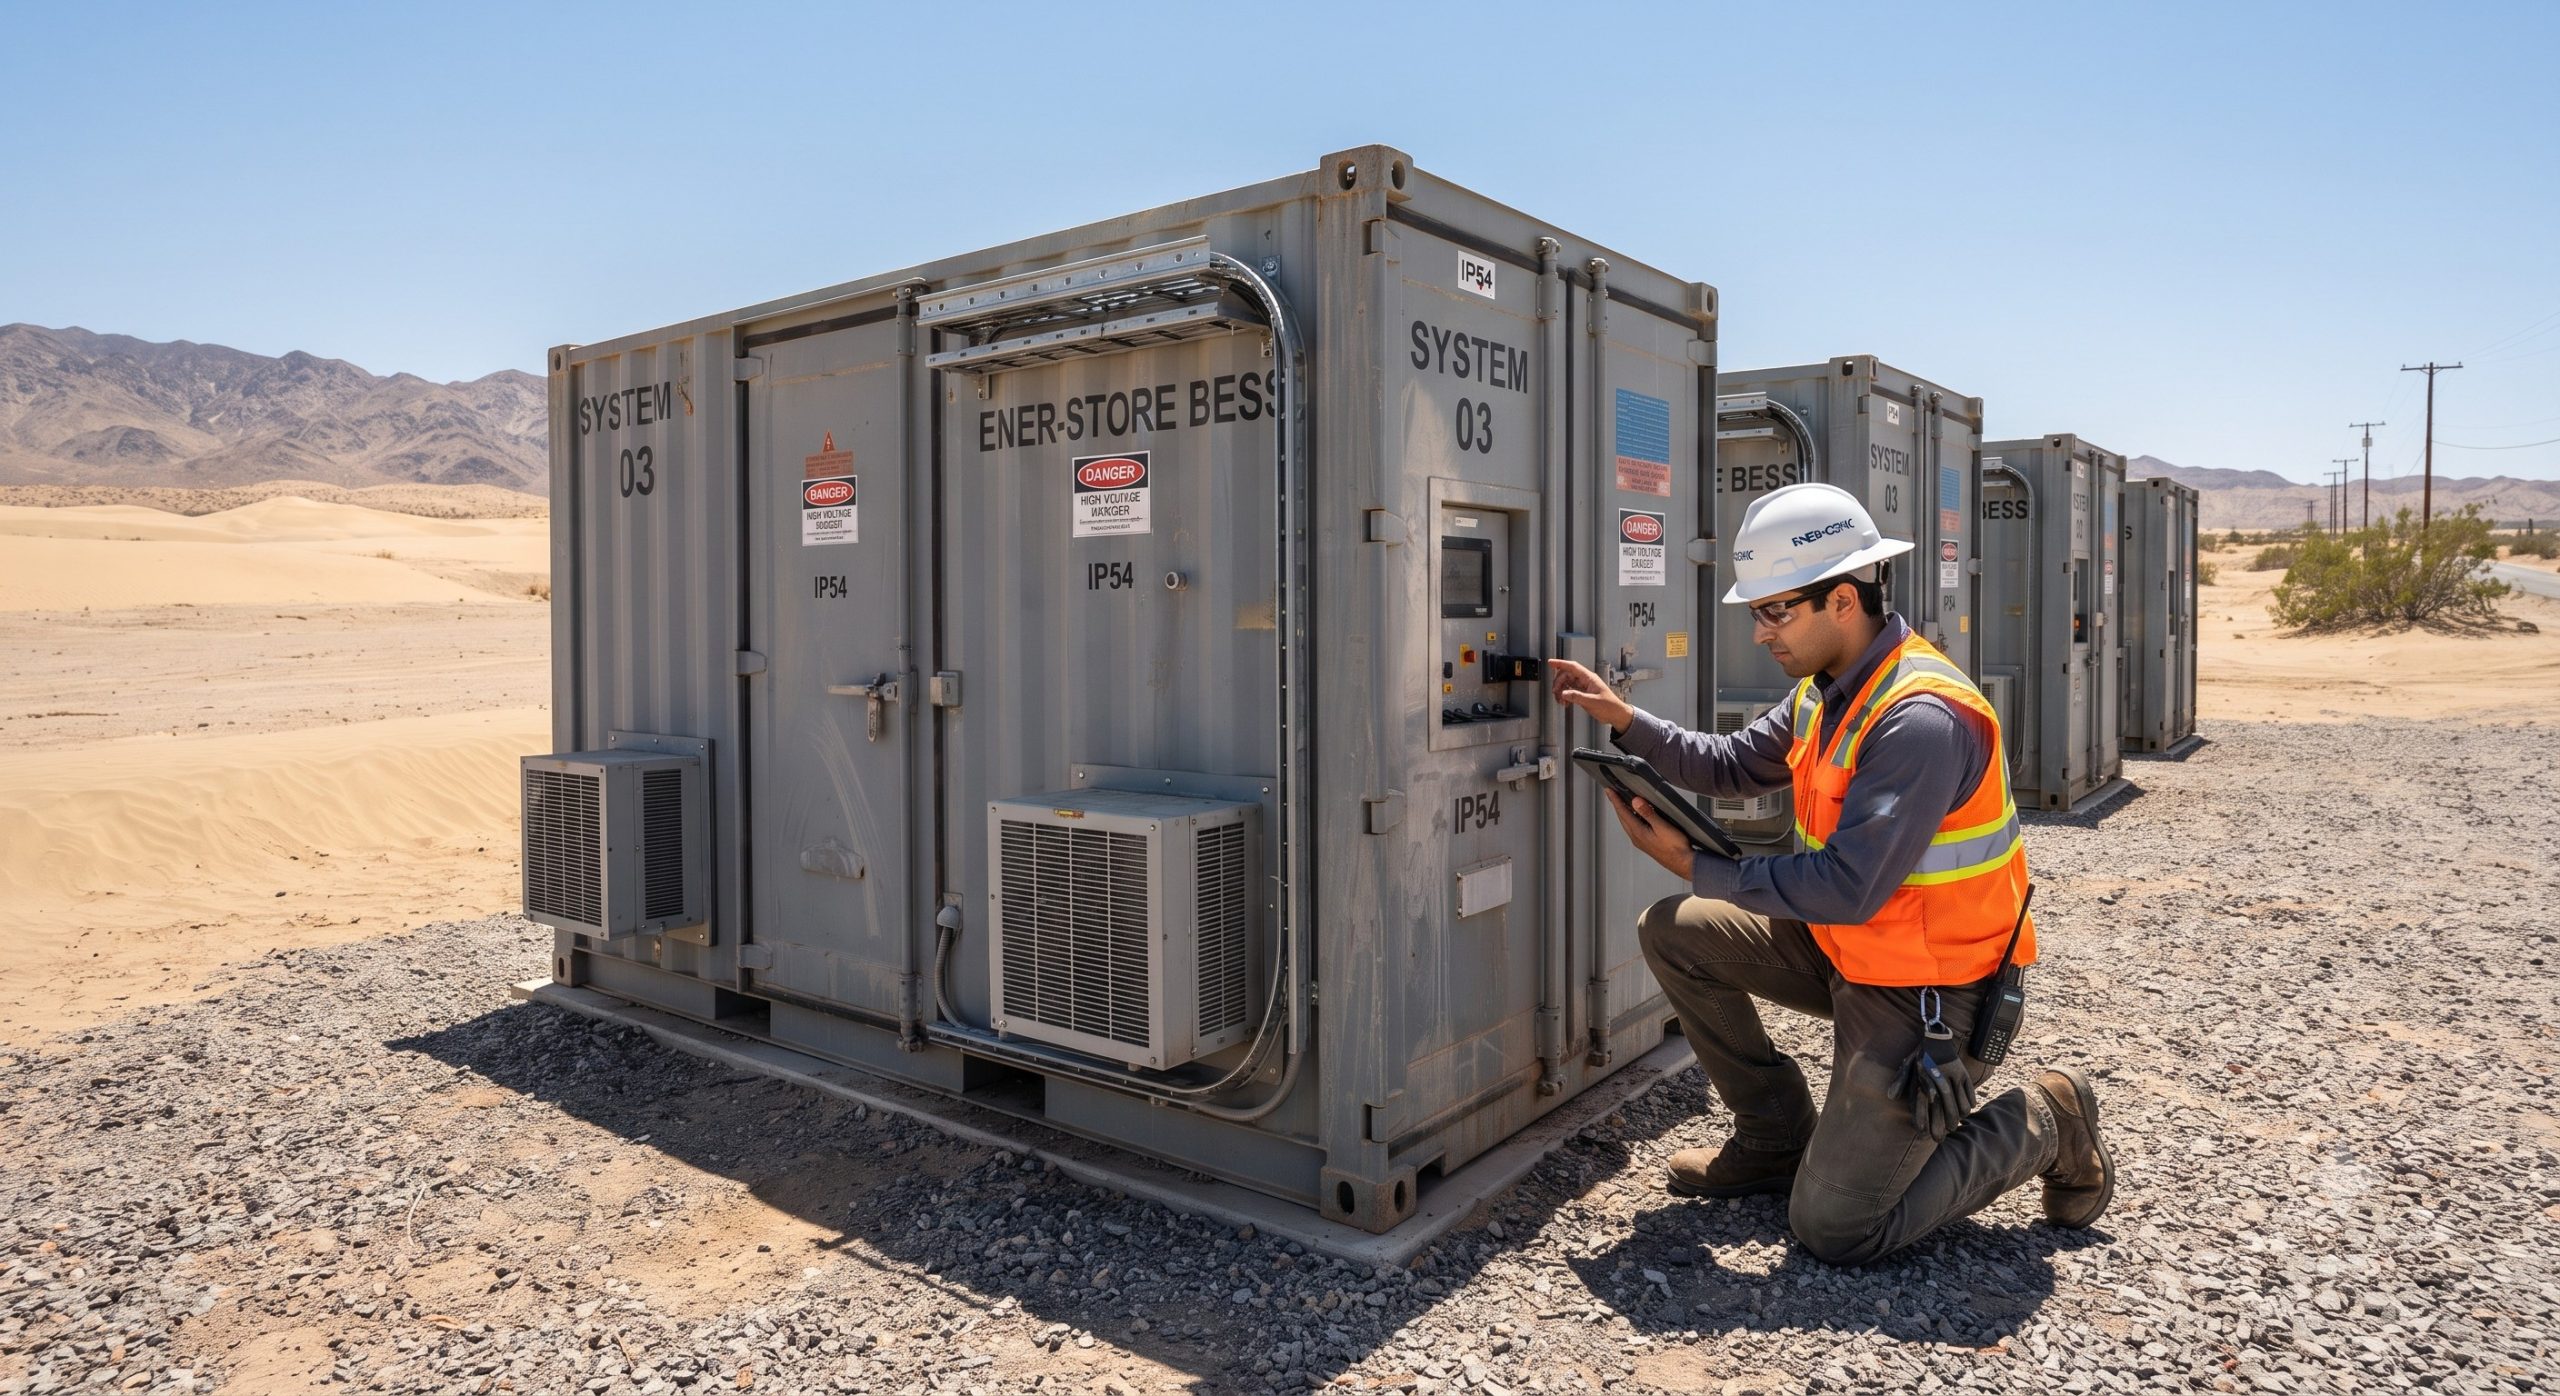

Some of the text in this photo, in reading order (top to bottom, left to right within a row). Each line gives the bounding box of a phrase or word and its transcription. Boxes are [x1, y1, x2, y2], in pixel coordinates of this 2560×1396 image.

[1461, 259, 1493, 290] IP54
[1410, 320, 1528, 394] SYSTEM
[579, 381, 671, 435] SYSTEM
[979, 384, 1177, 452] ENER-STORE
[1455, 397, 1493, 454] 03
[619, 445, 656, 499] 03
[1085, 465, 1135, 482] DANGER
[1885, 484, 1898, 513] 03
[814, 575, 848, 599] IP54
[1088, 562, 1134, 591] IP54
[1629, 602, 1655, 627] IP54
[1454, 790, 1501, 835] IP54
